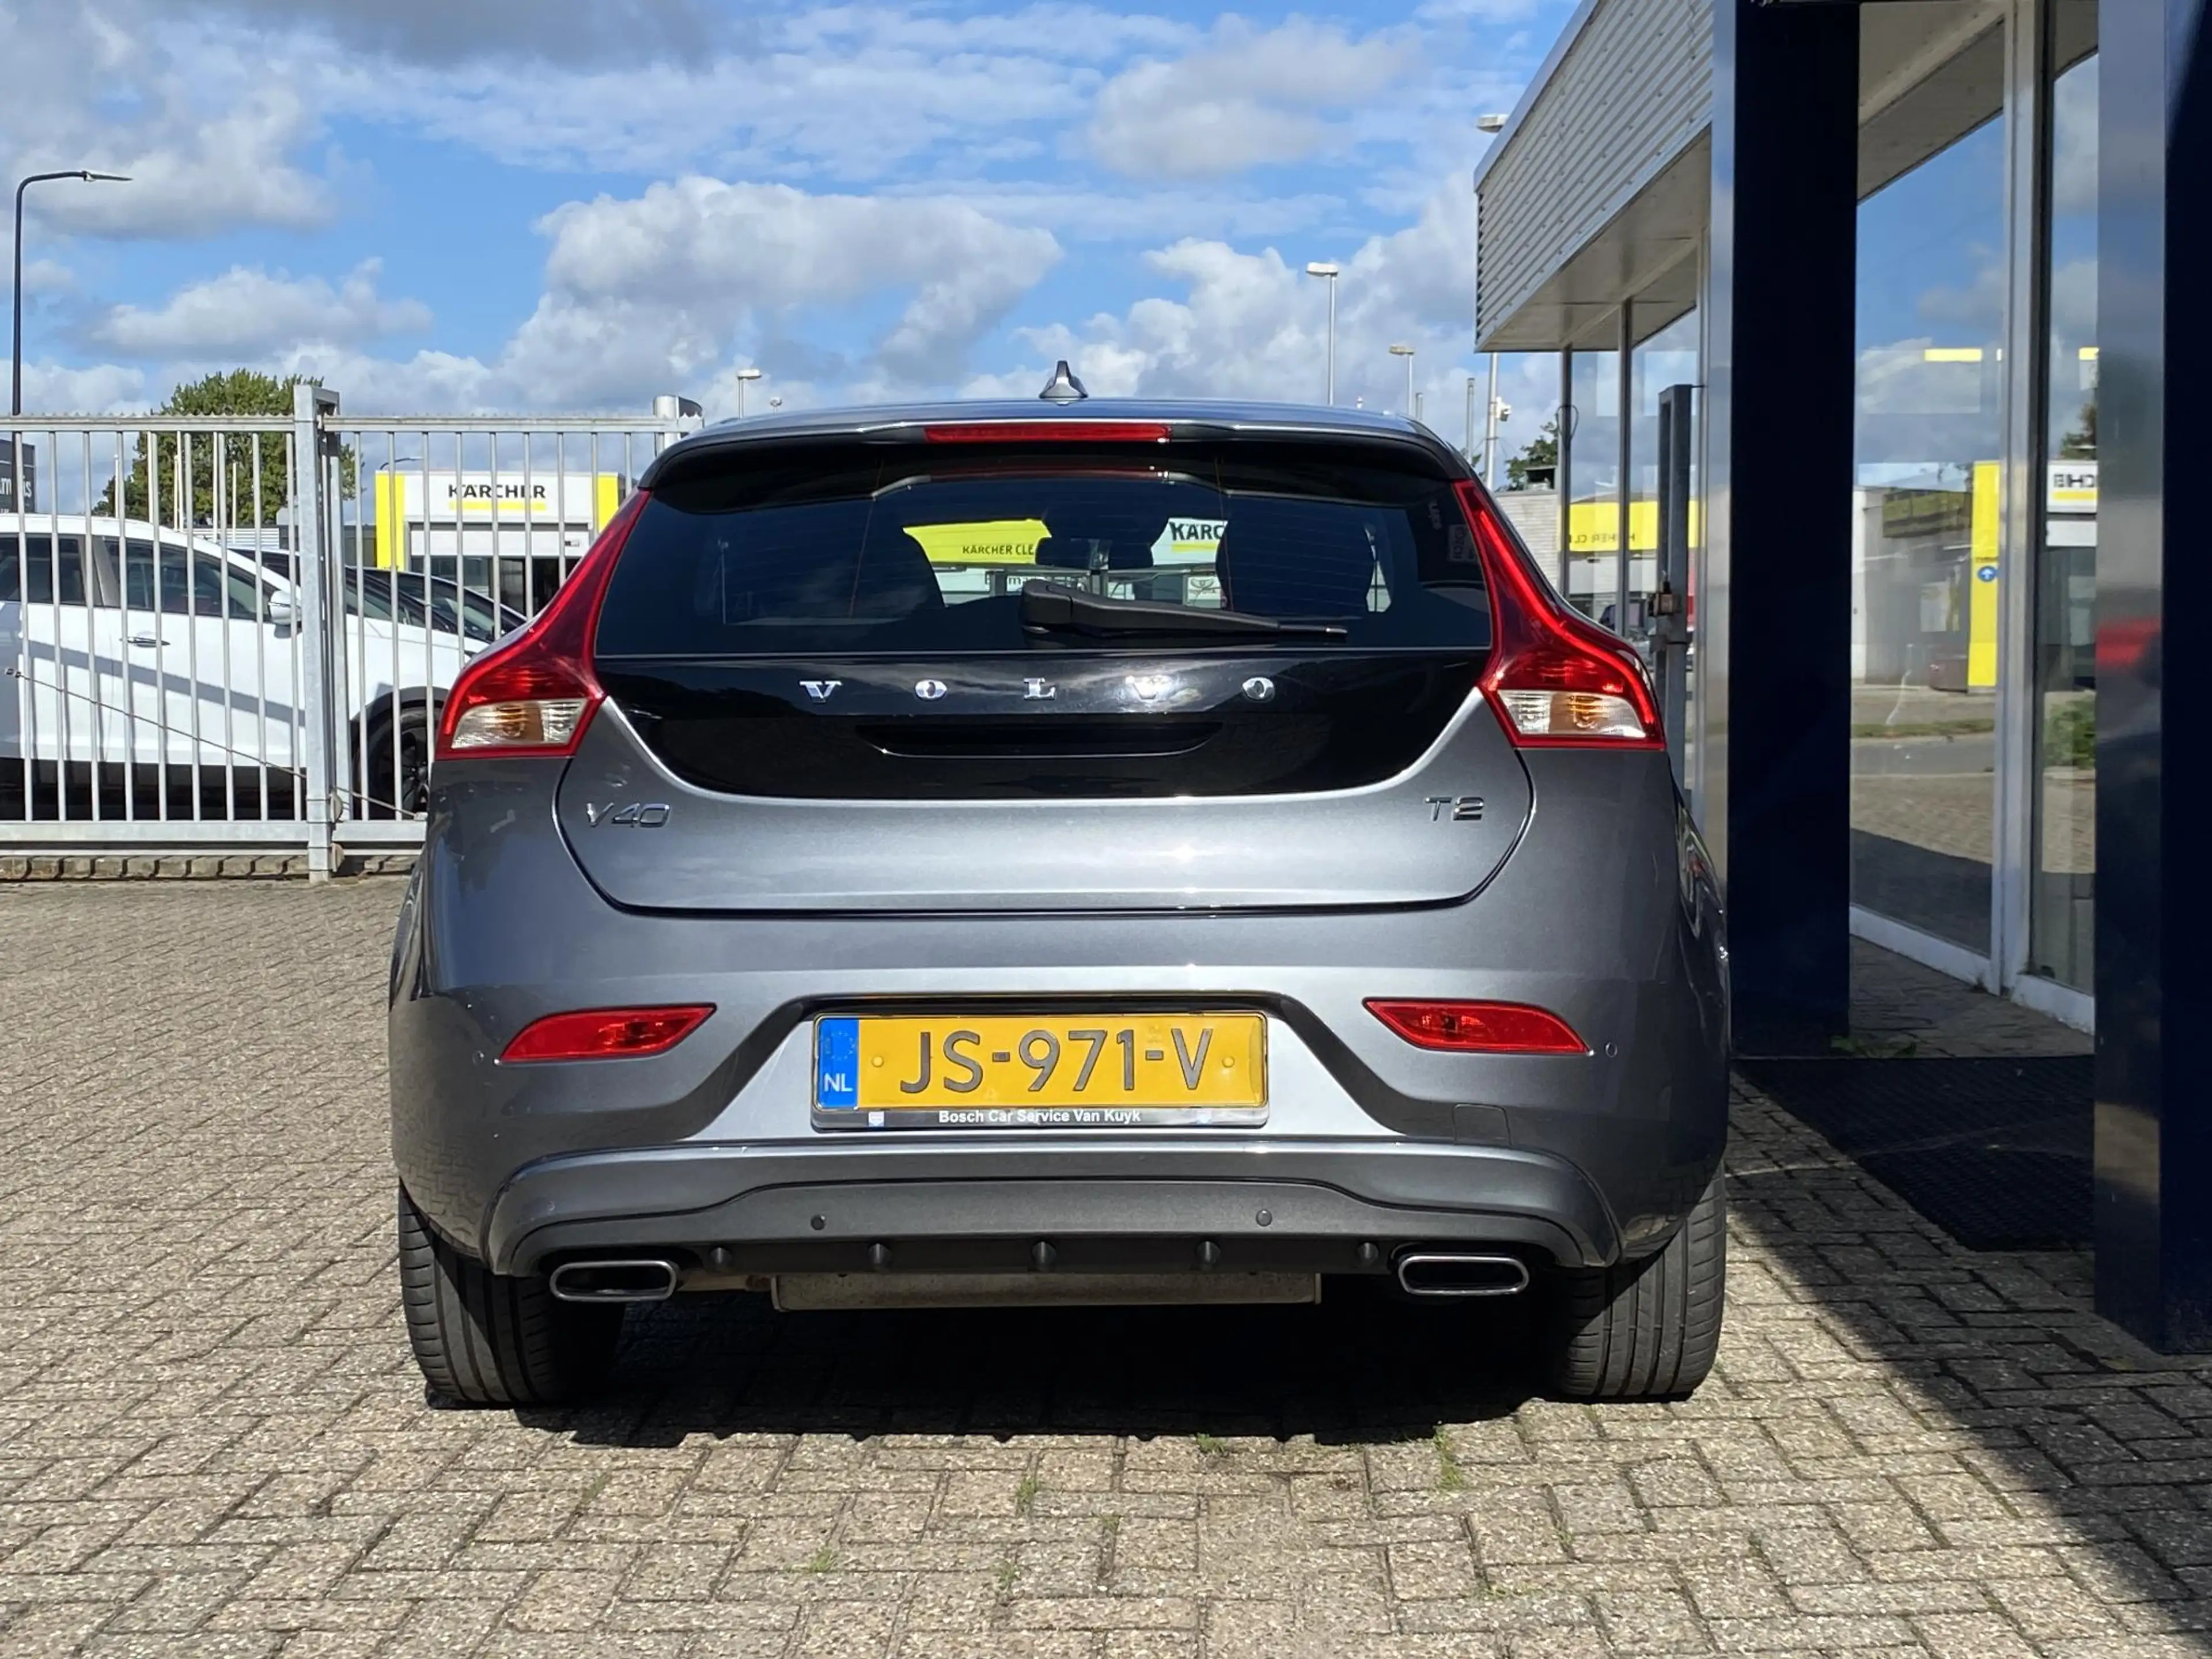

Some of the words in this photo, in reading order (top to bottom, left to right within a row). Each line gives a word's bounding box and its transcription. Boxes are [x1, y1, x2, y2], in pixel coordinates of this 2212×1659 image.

[799, 676, 1275, 704] VOLVO
[586, 801, 671, 828] V40
[1425, 796, 1484, 821] T2
[899, 1028, 1214, 1094] JS-971-V
[823, 1073, 853, 1092] NL
[938, 1109, 984, 1123] Bosch
[988, 1109, 1013, 1122] Car
[1016, 1108, 1070, 1123] Service
[1073, 1108, 1100, 1122] Van
[1104, 1108, 1141, 1124] Kuyk
